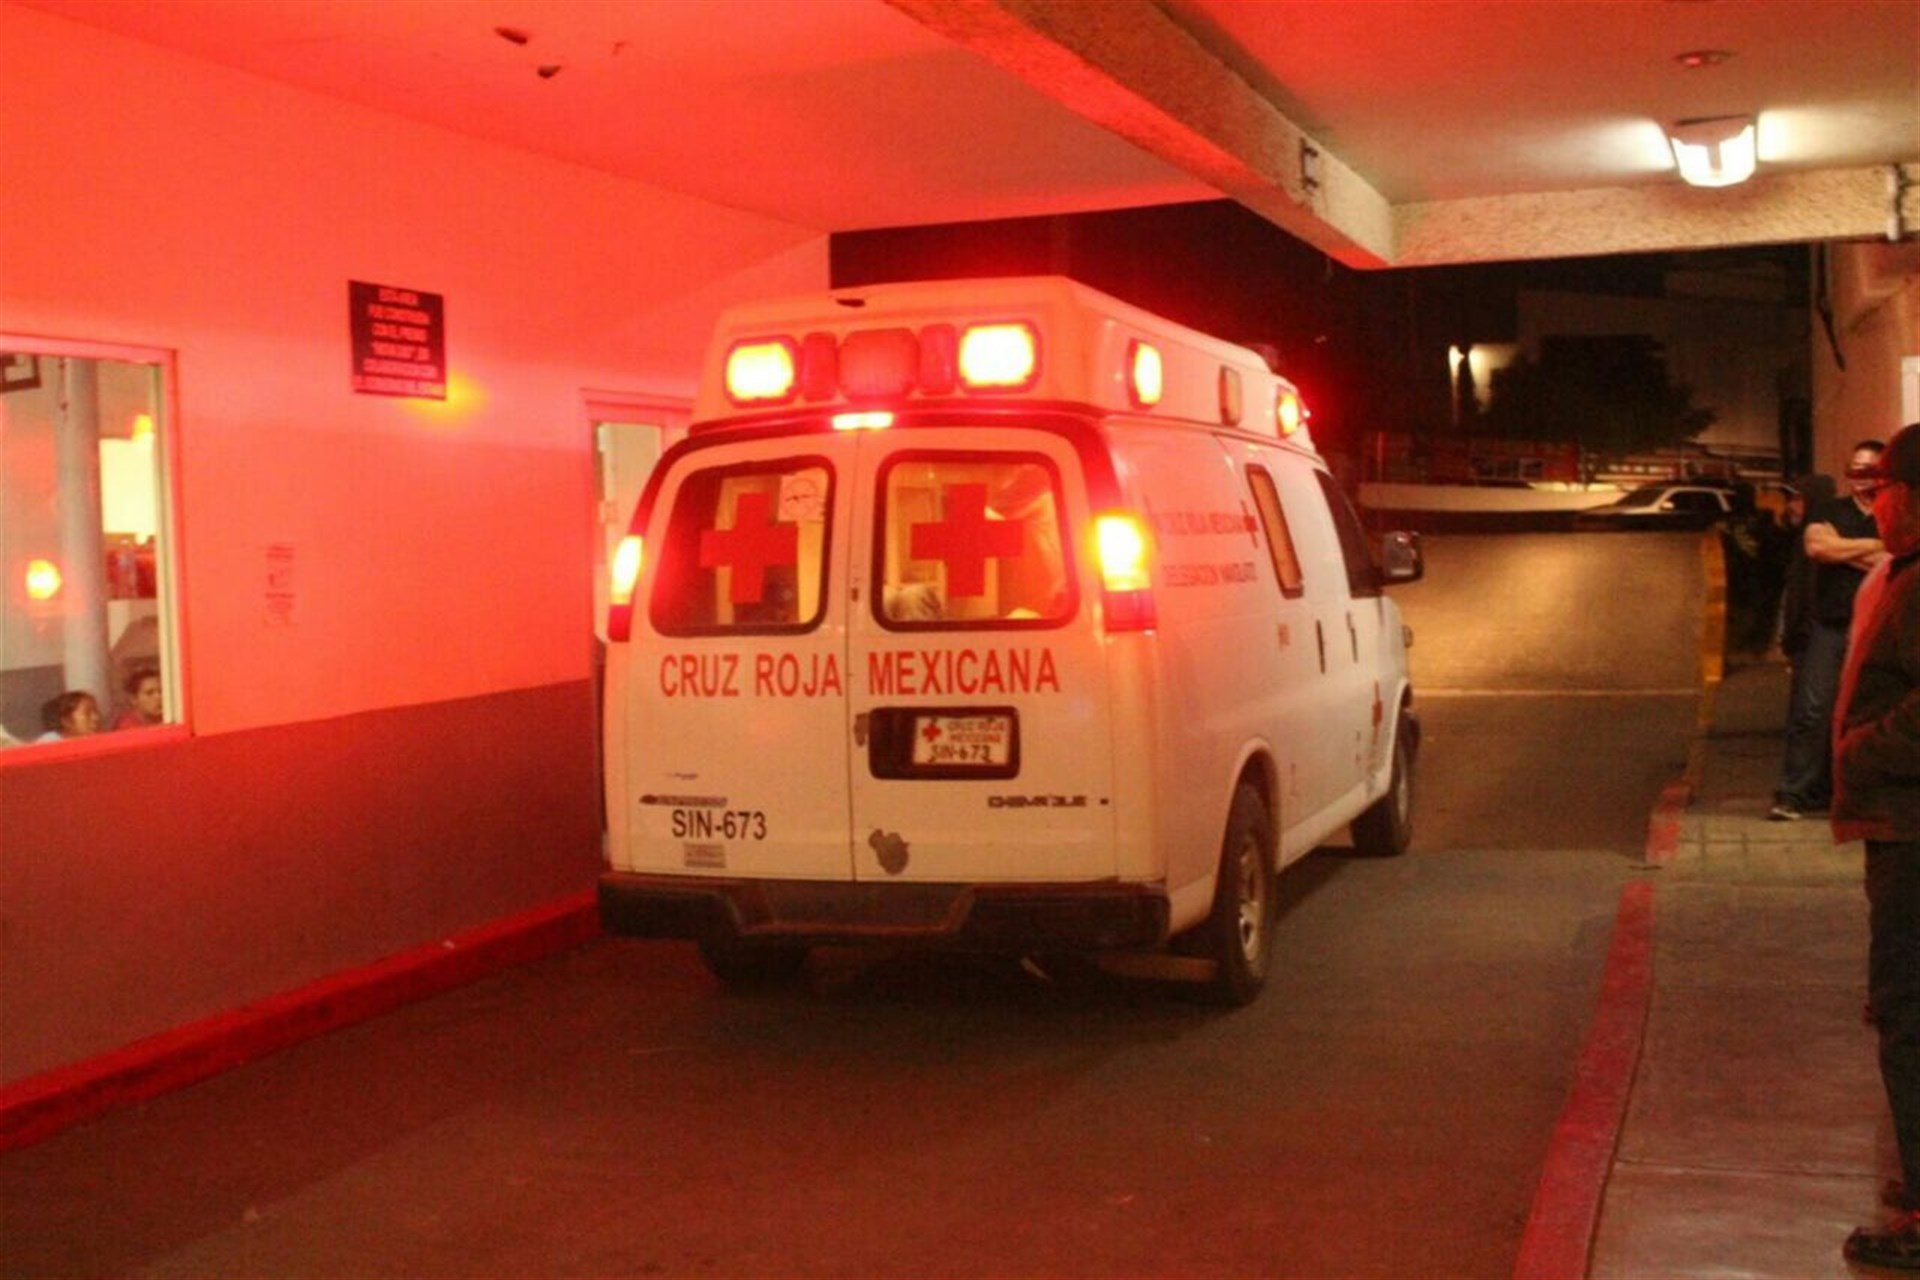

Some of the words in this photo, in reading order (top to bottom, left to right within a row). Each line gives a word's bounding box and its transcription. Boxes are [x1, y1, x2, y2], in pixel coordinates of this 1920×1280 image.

[660, 654, 740, 697] CRUZ
[755, 653, 842, 697] ROJA
[868, 648, 1060, 695] MEXICANA
[671, 809, 767, 840] SIN-673
